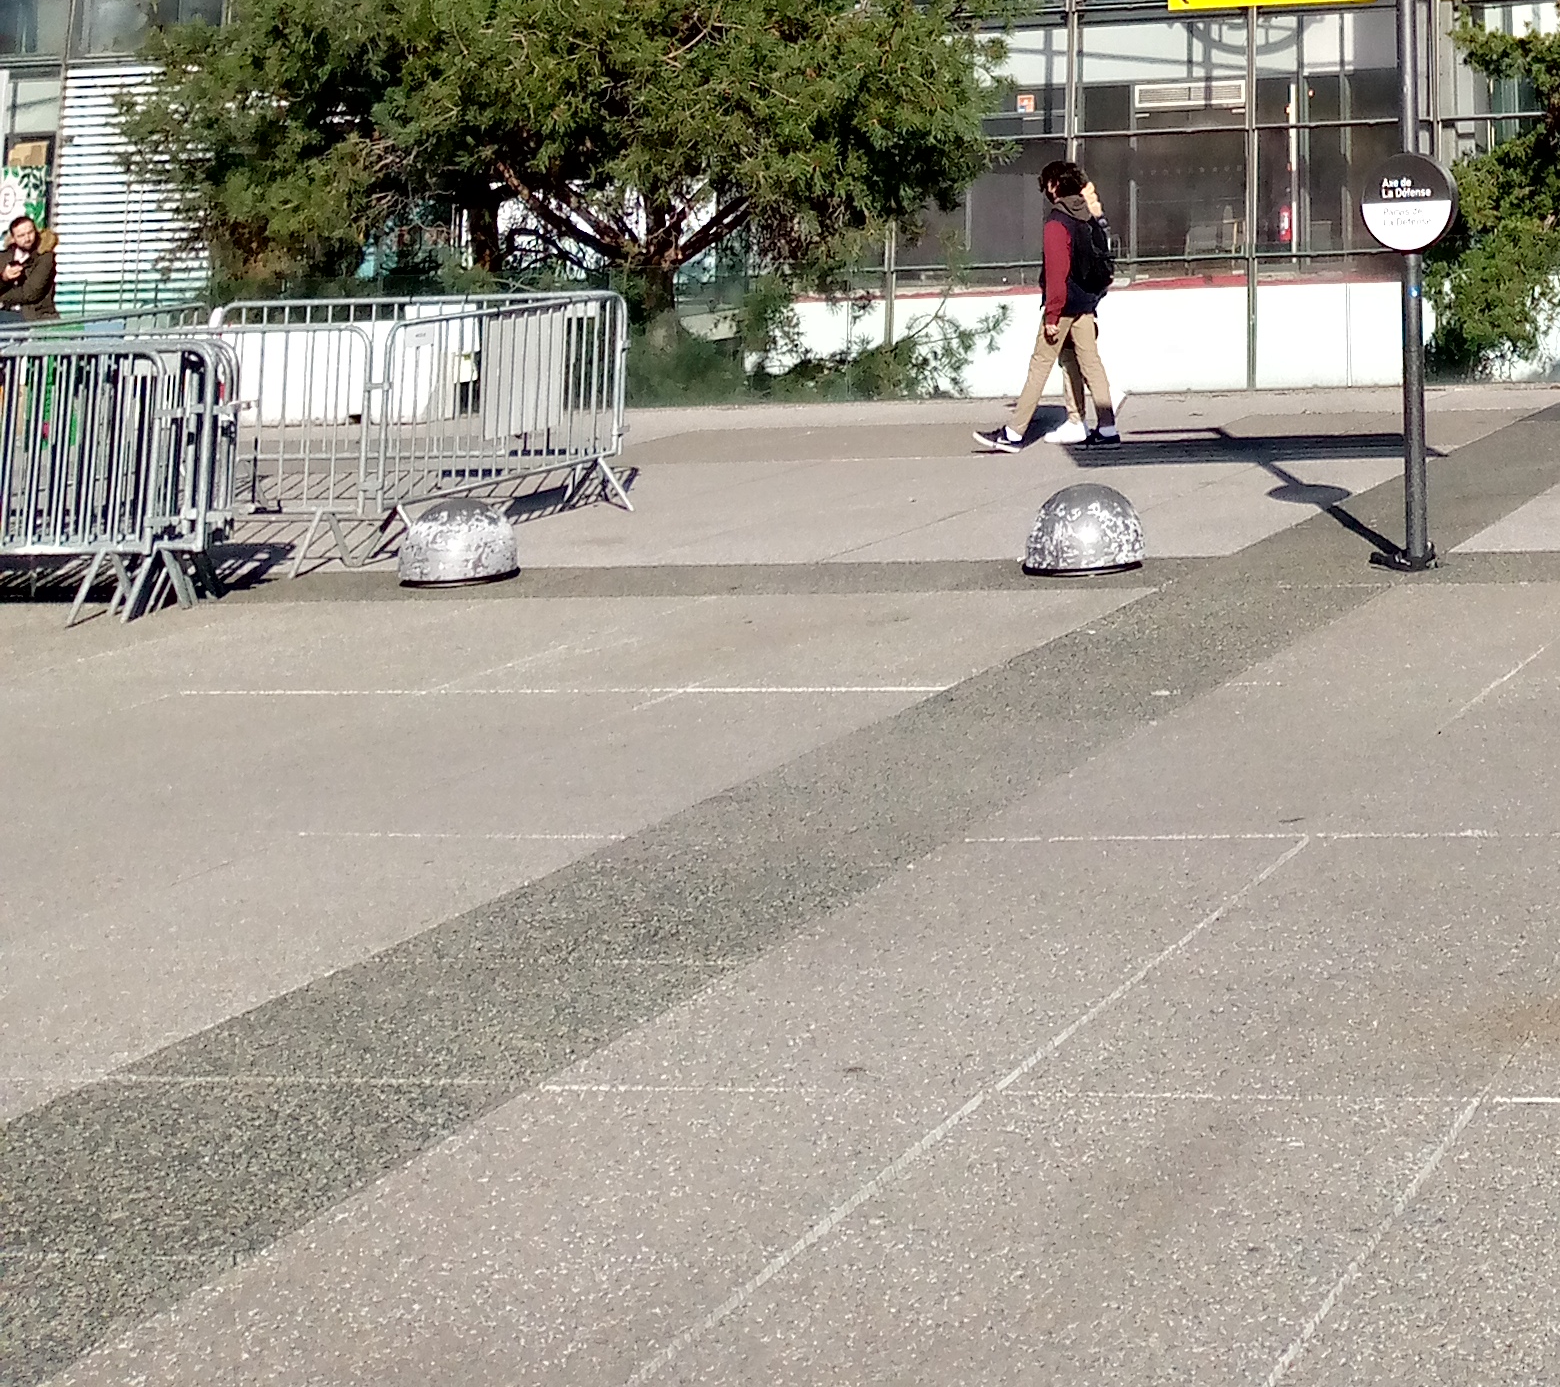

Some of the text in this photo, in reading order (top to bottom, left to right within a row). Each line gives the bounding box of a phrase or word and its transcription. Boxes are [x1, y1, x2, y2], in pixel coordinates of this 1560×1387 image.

[1381, 176, 1412, 188] Axe de
[1381, 187, 1432, 199] La Défense
